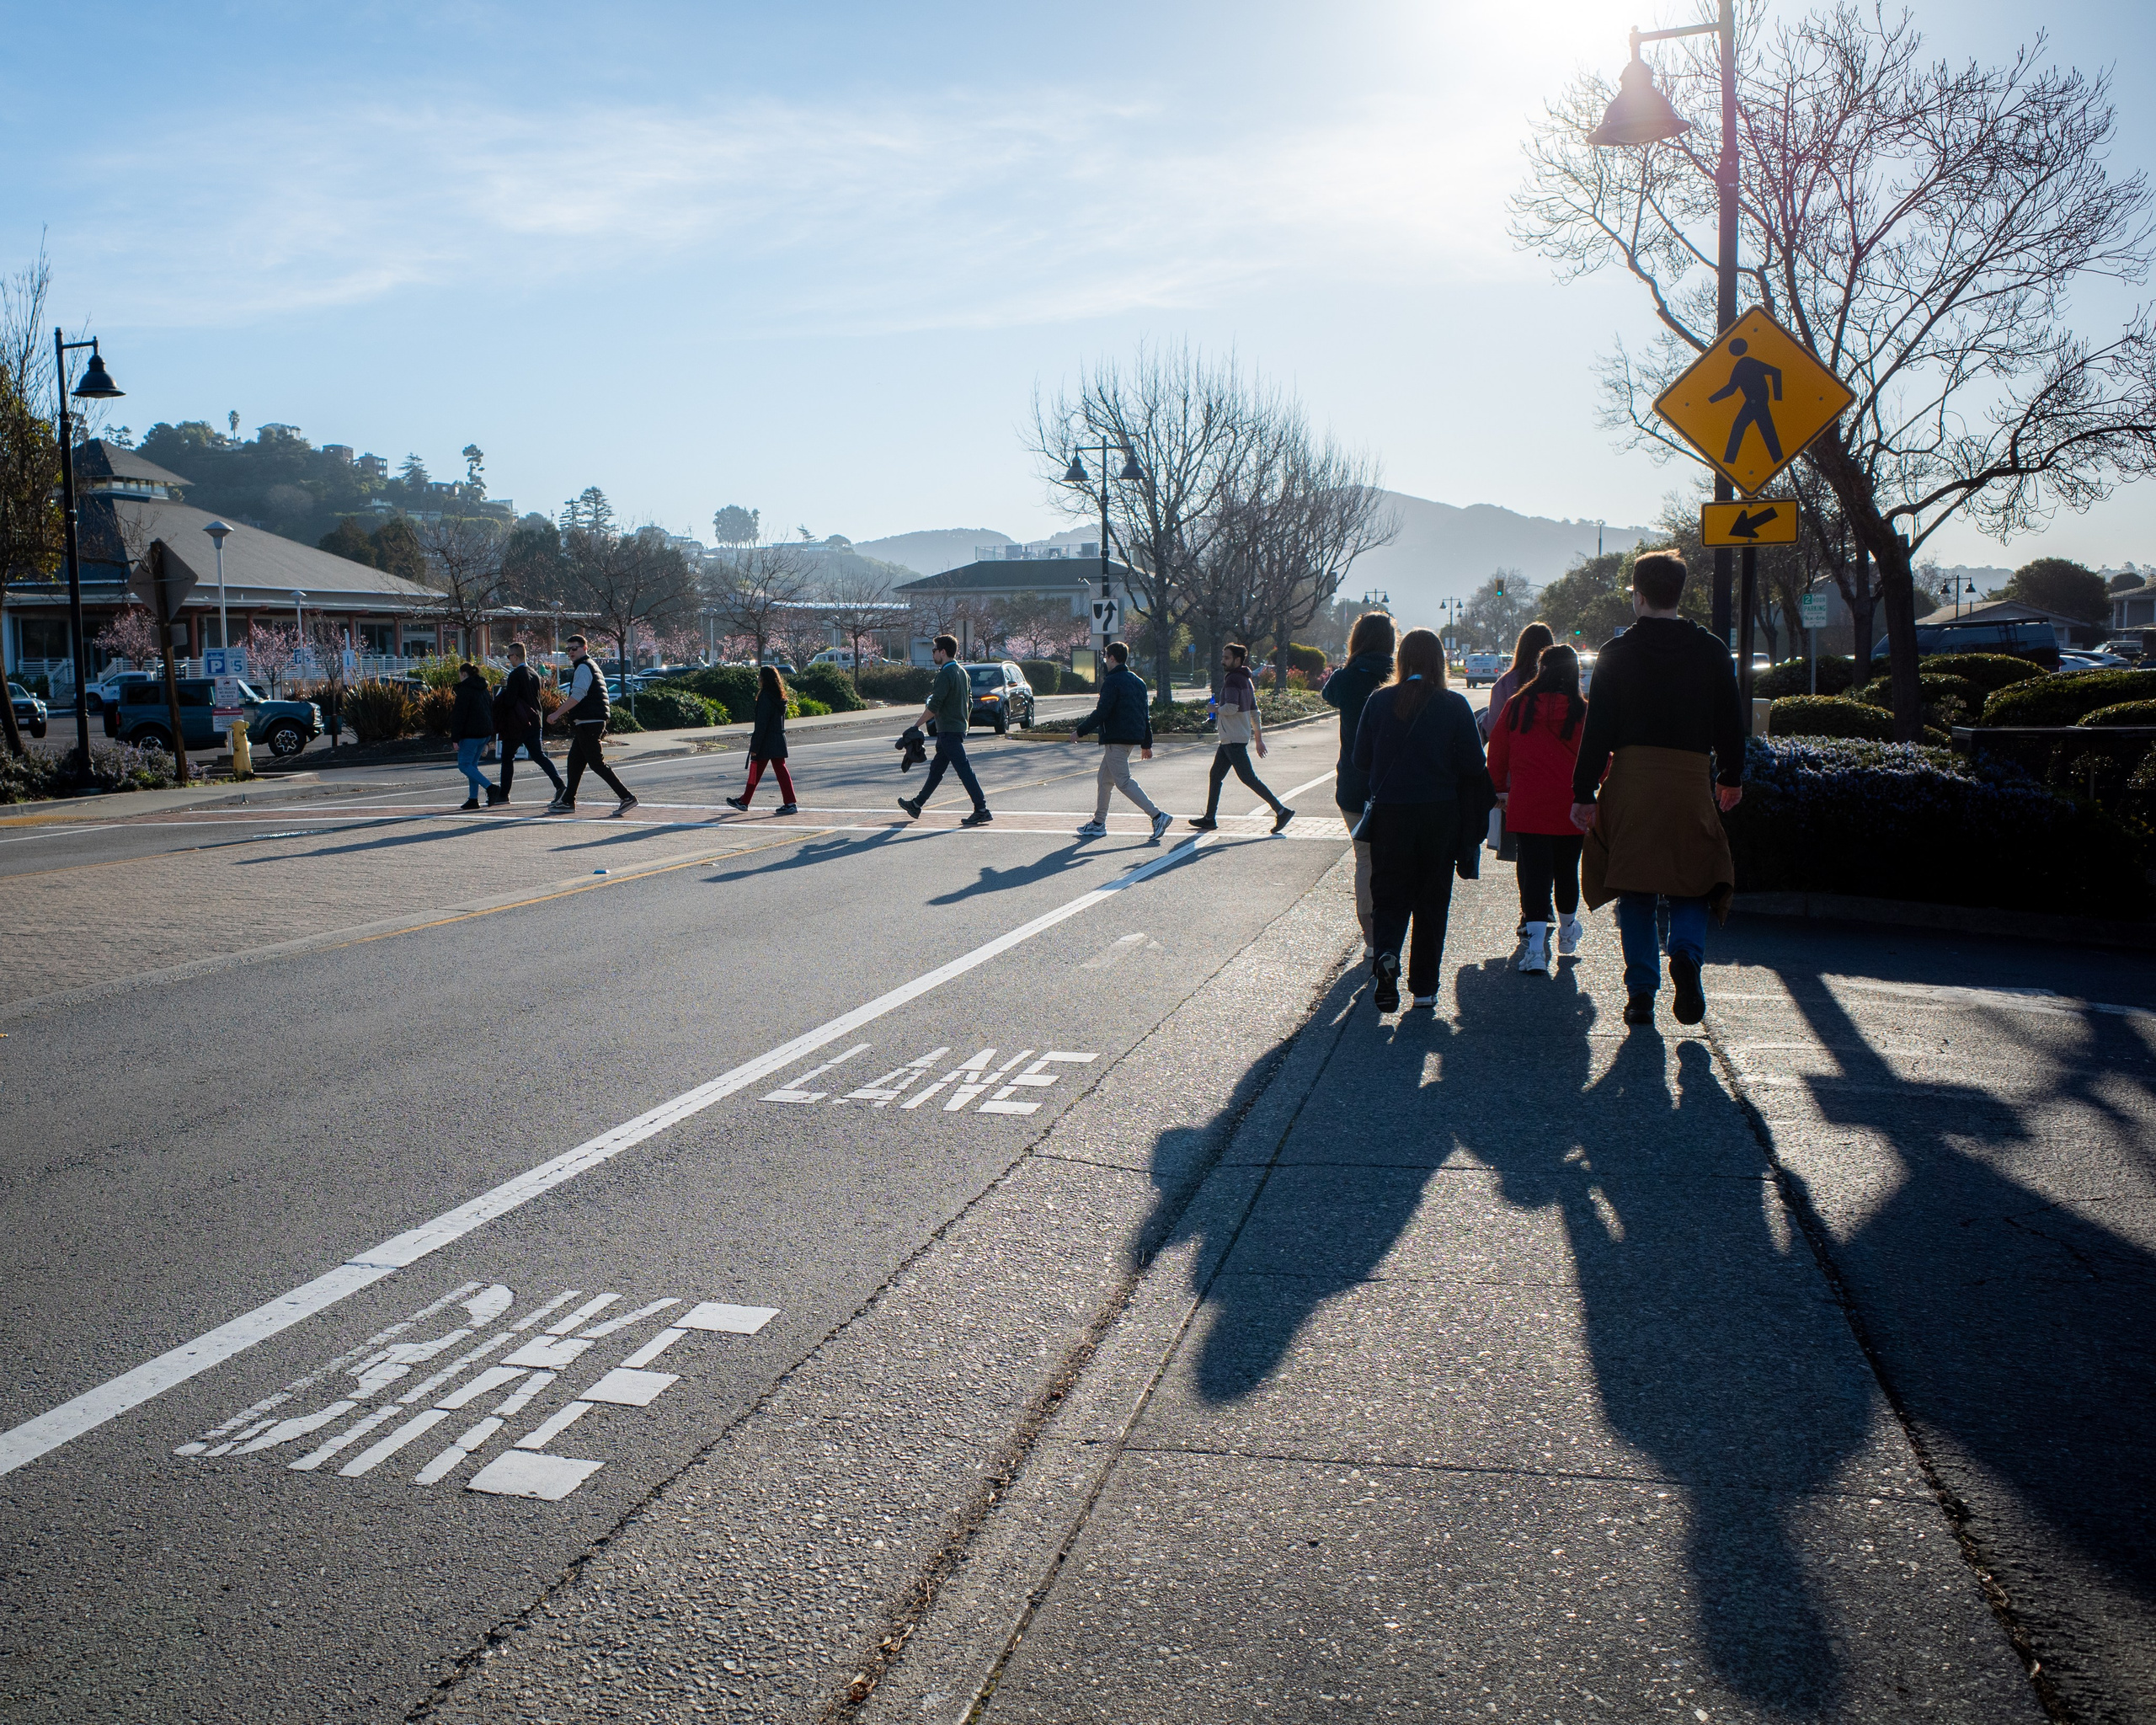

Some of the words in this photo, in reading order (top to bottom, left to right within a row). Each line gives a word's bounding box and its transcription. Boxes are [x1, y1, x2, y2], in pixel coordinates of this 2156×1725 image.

[211, 660, 223, 673] P
[757, 1044, 1100, 1115] LANE
[173, 1281, 781, 1501] BIKE
